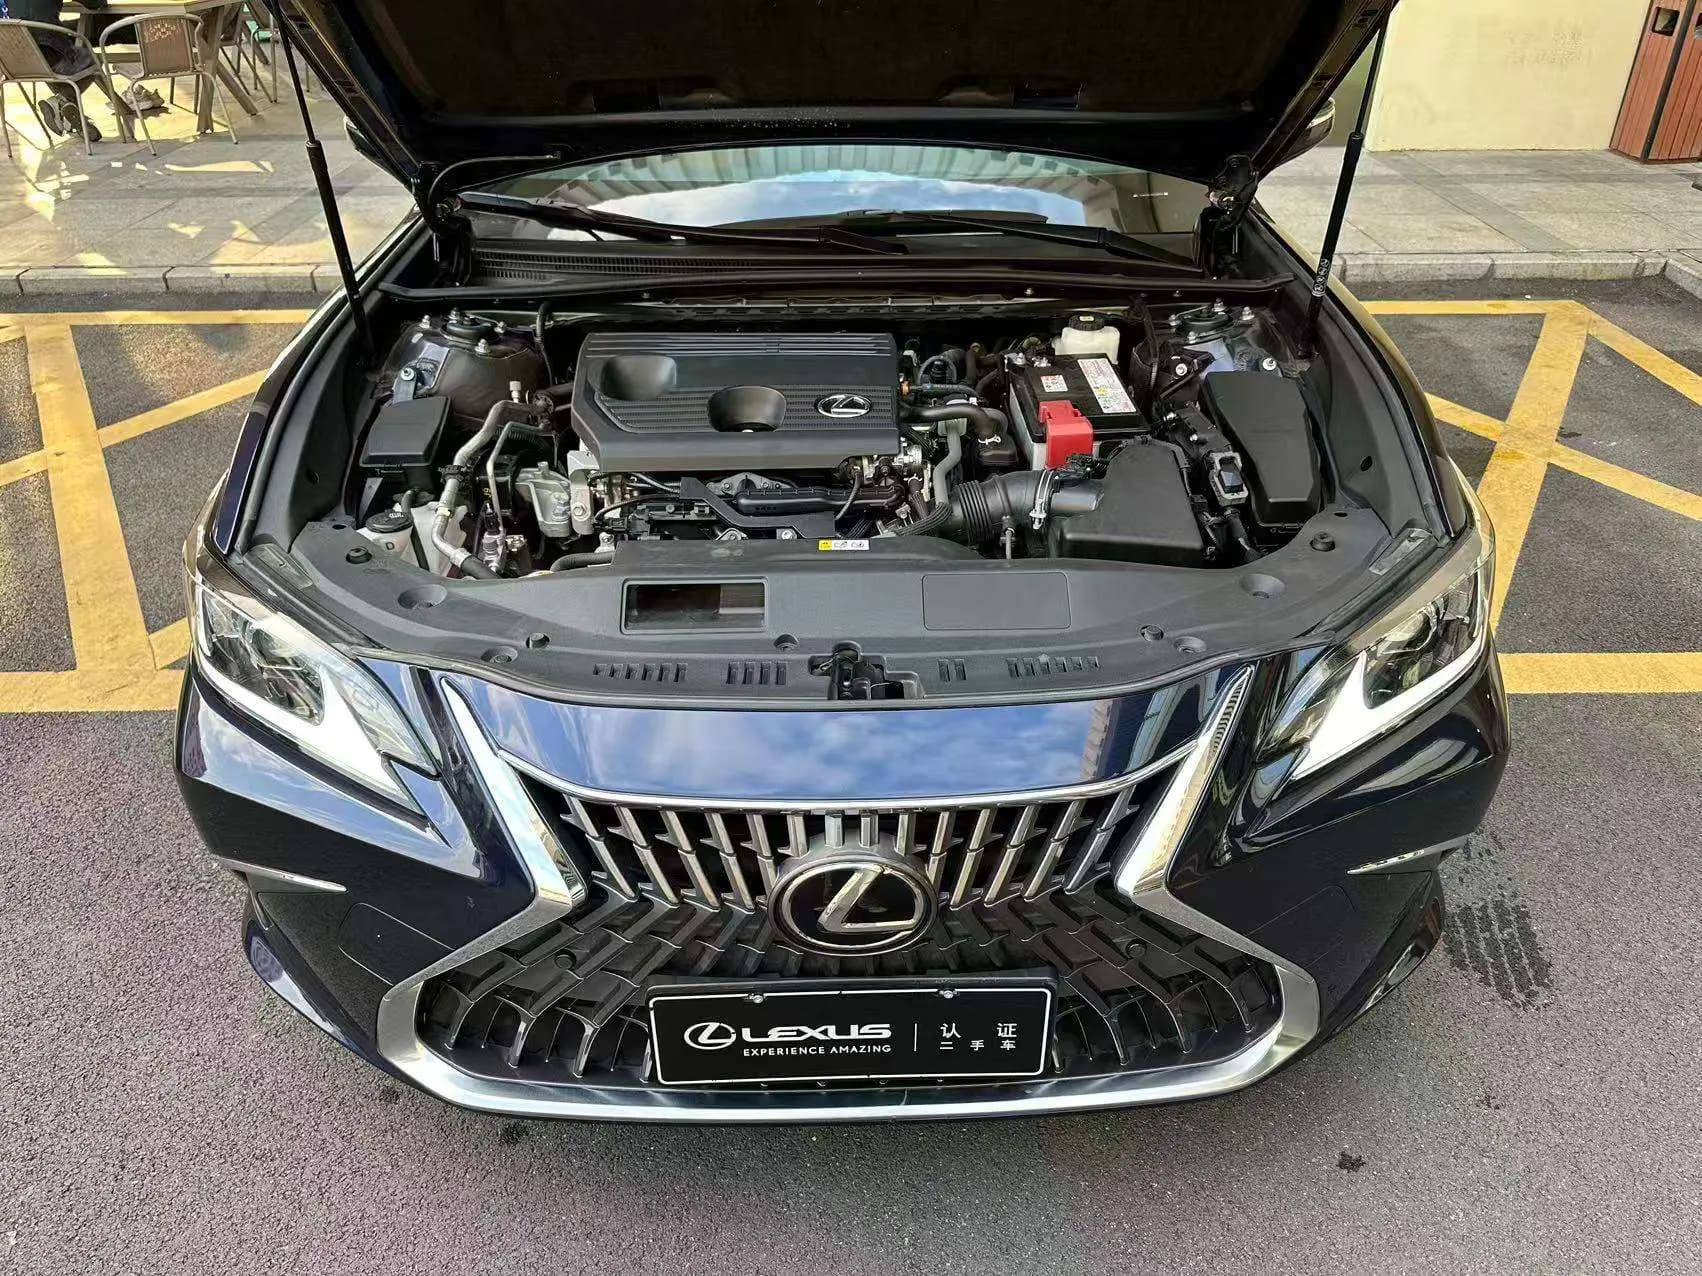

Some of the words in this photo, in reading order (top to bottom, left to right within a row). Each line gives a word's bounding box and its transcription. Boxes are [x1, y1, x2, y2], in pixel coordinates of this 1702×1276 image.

[741, 1023, 892, 1042] LEXUS
[743, 1046, 825, 1057] EXPERIENCE
[830, 1044, 892, 1054] AMAZING
